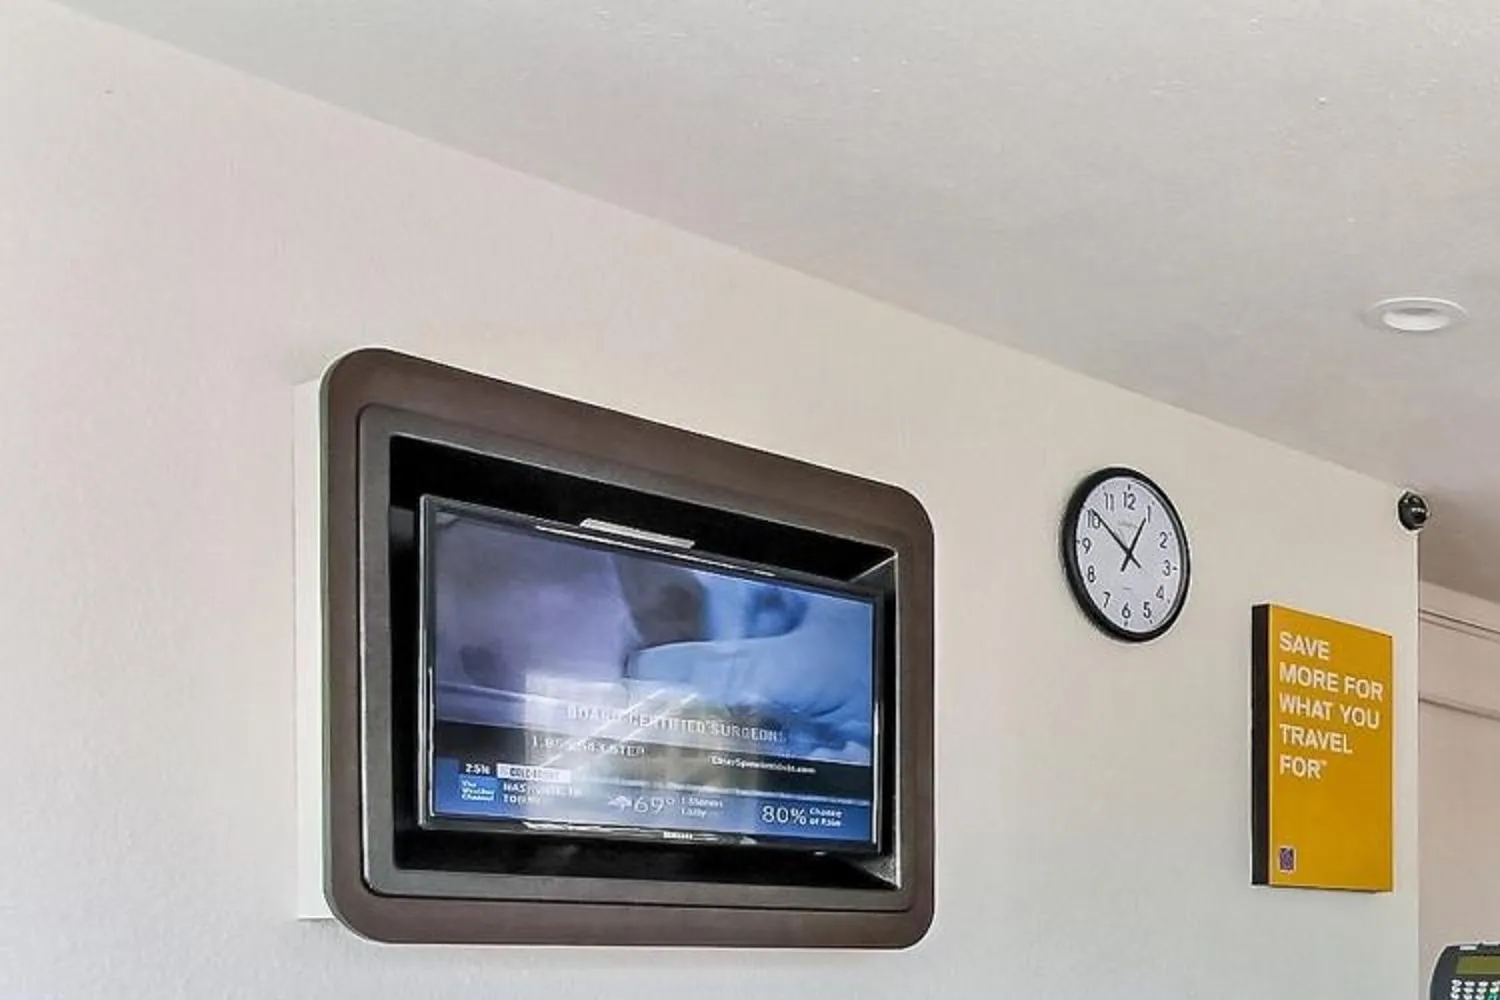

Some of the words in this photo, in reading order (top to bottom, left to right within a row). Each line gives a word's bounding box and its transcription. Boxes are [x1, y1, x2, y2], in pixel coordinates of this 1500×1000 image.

[1104, 492, 1115, 512] 11
[1122, 491, 1137, 511] 12
[1087, 509, 1101, 530] 10
[1082, 537, 1092, 554] 9
[1159, 531, 1169, 549] 2
[1087, 565, 1096, 583] 8
[1162, 559, 1171, 577] 3
[1103, 591, 1111, 609] 7
[1156, 585, 1165, 601] 4
[1121, 602, 1131, 619] 6
[1143, 601, 1152, 619] 5
[1279, 631, 1330, 661] SAVE
[1279, 662, 1340, 693] MORE
[1343, 677, 1384, 701] FOR
[1279, 692, 1333, 721] WHAT
[1340, 705, 1380, 730] YOU
[1279, 724, 1353, 754] TRAVEL
[762, 805, 806, 826] 80%
